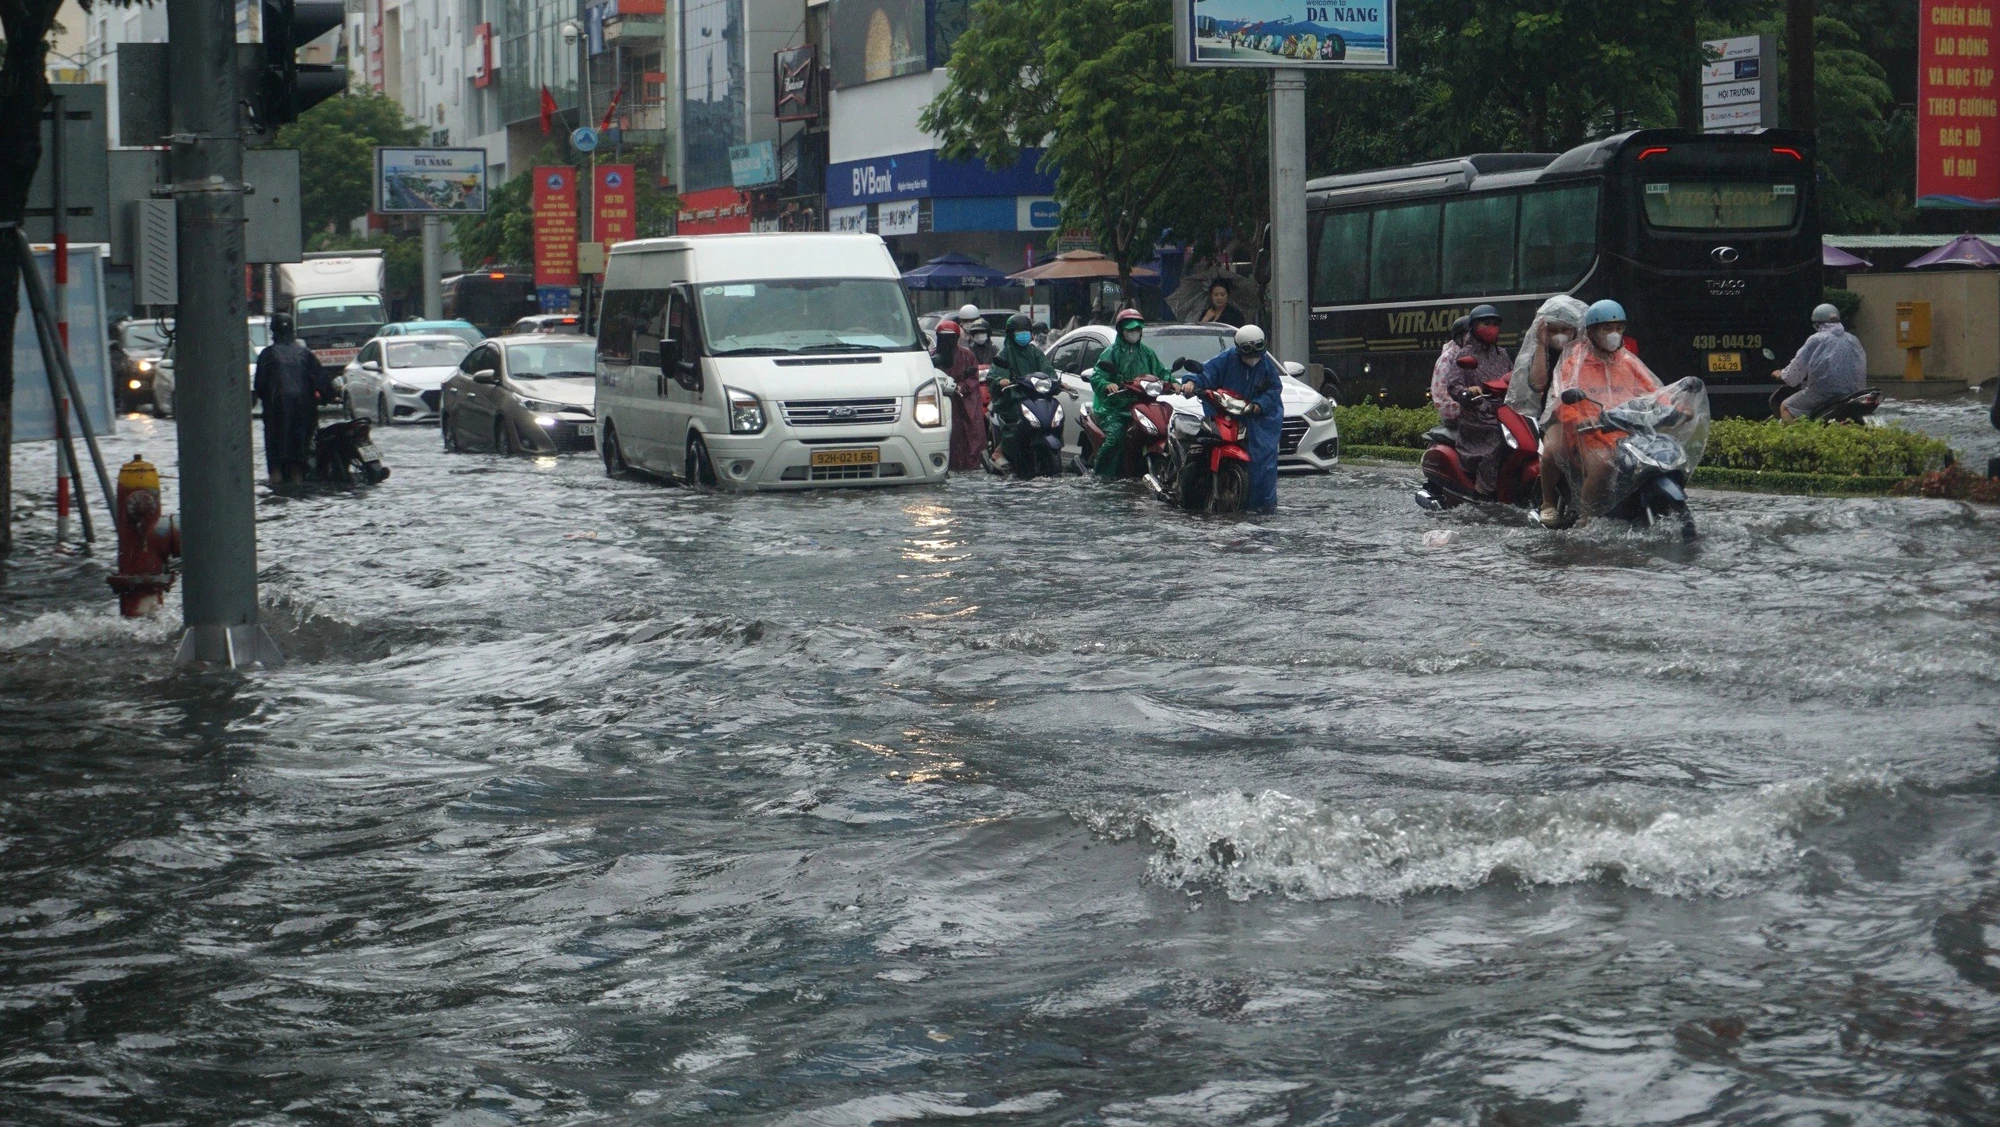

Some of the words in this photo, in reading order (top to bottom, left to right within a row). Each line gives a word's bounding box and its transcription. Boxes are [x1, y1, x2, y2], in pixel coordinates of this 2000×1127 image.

[1307, 7, 1329, 22] DA
[1334, 7, 1378, 22] NANG
[1932, 1, 1965, 25] CHIẾN
[1935, 37, 1955, 56] LAO
[1958, 35, 1989, 59] ĐỘNG
[1947, 67, 1970, 89] HỌC
[1928, 97, 1956, 116] THEO
[1940, 125, 1963, 147] BÁC
[428, 158, 453, 166] NANG
[1957, 158, 1977, 180] ĐẠI
[852, 165, 892, 197] BVBank
[1706, 280, 1745, 288] THACO
[1693, 335, 1762, 349] 43B-044.29
[1712, 362, 1739, 371] 044.29
[1718, 354, 1732, 362] 43B
[817, 452, 873, 463] 92H-021.66
